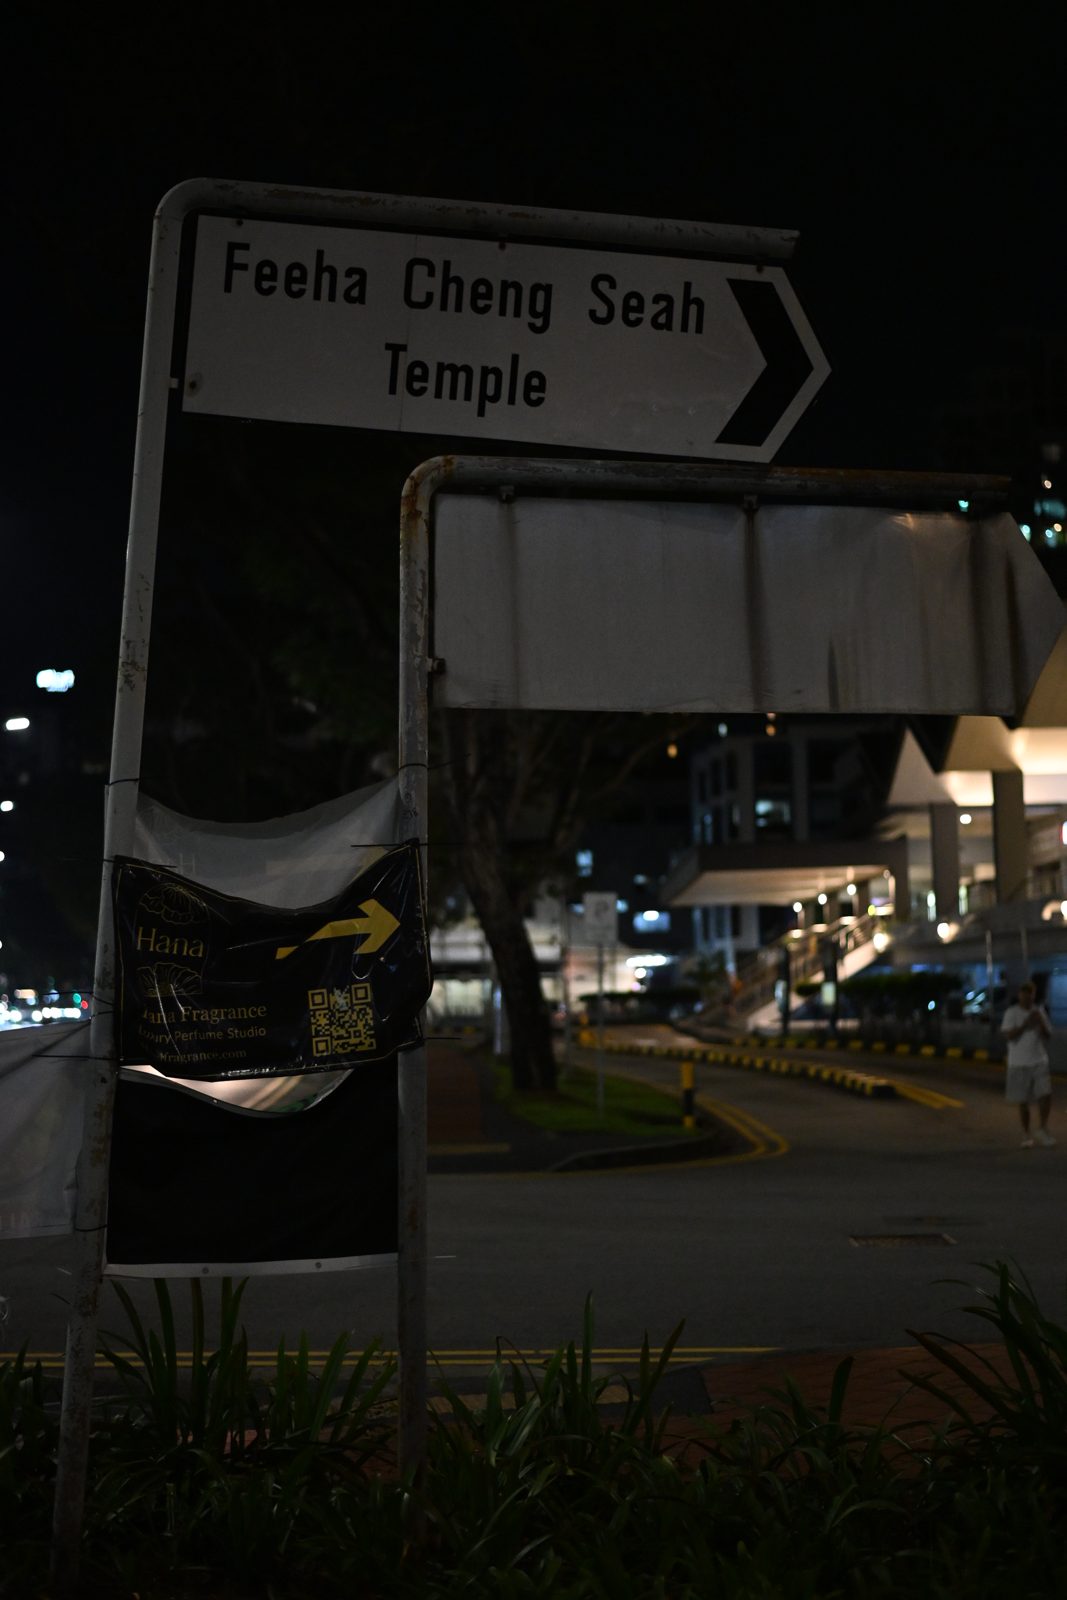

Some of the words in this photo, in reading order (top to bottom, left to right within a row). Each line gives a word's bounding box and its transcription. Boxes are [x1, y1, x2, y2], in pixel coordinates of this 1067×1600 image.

[223, 242, 368, 305] Feeha
[403, 257, 553, 334] Cheng
[588, 274, 706, 334] Seah
[384, 342, 547, 418] Temple
[135, 926, 205, 958] Hana
[179, 1005, 268, 1024] Fragrance
[174, 1029, 224, 1042] Perfume
[226, 1025, 267, 1040] Studio
